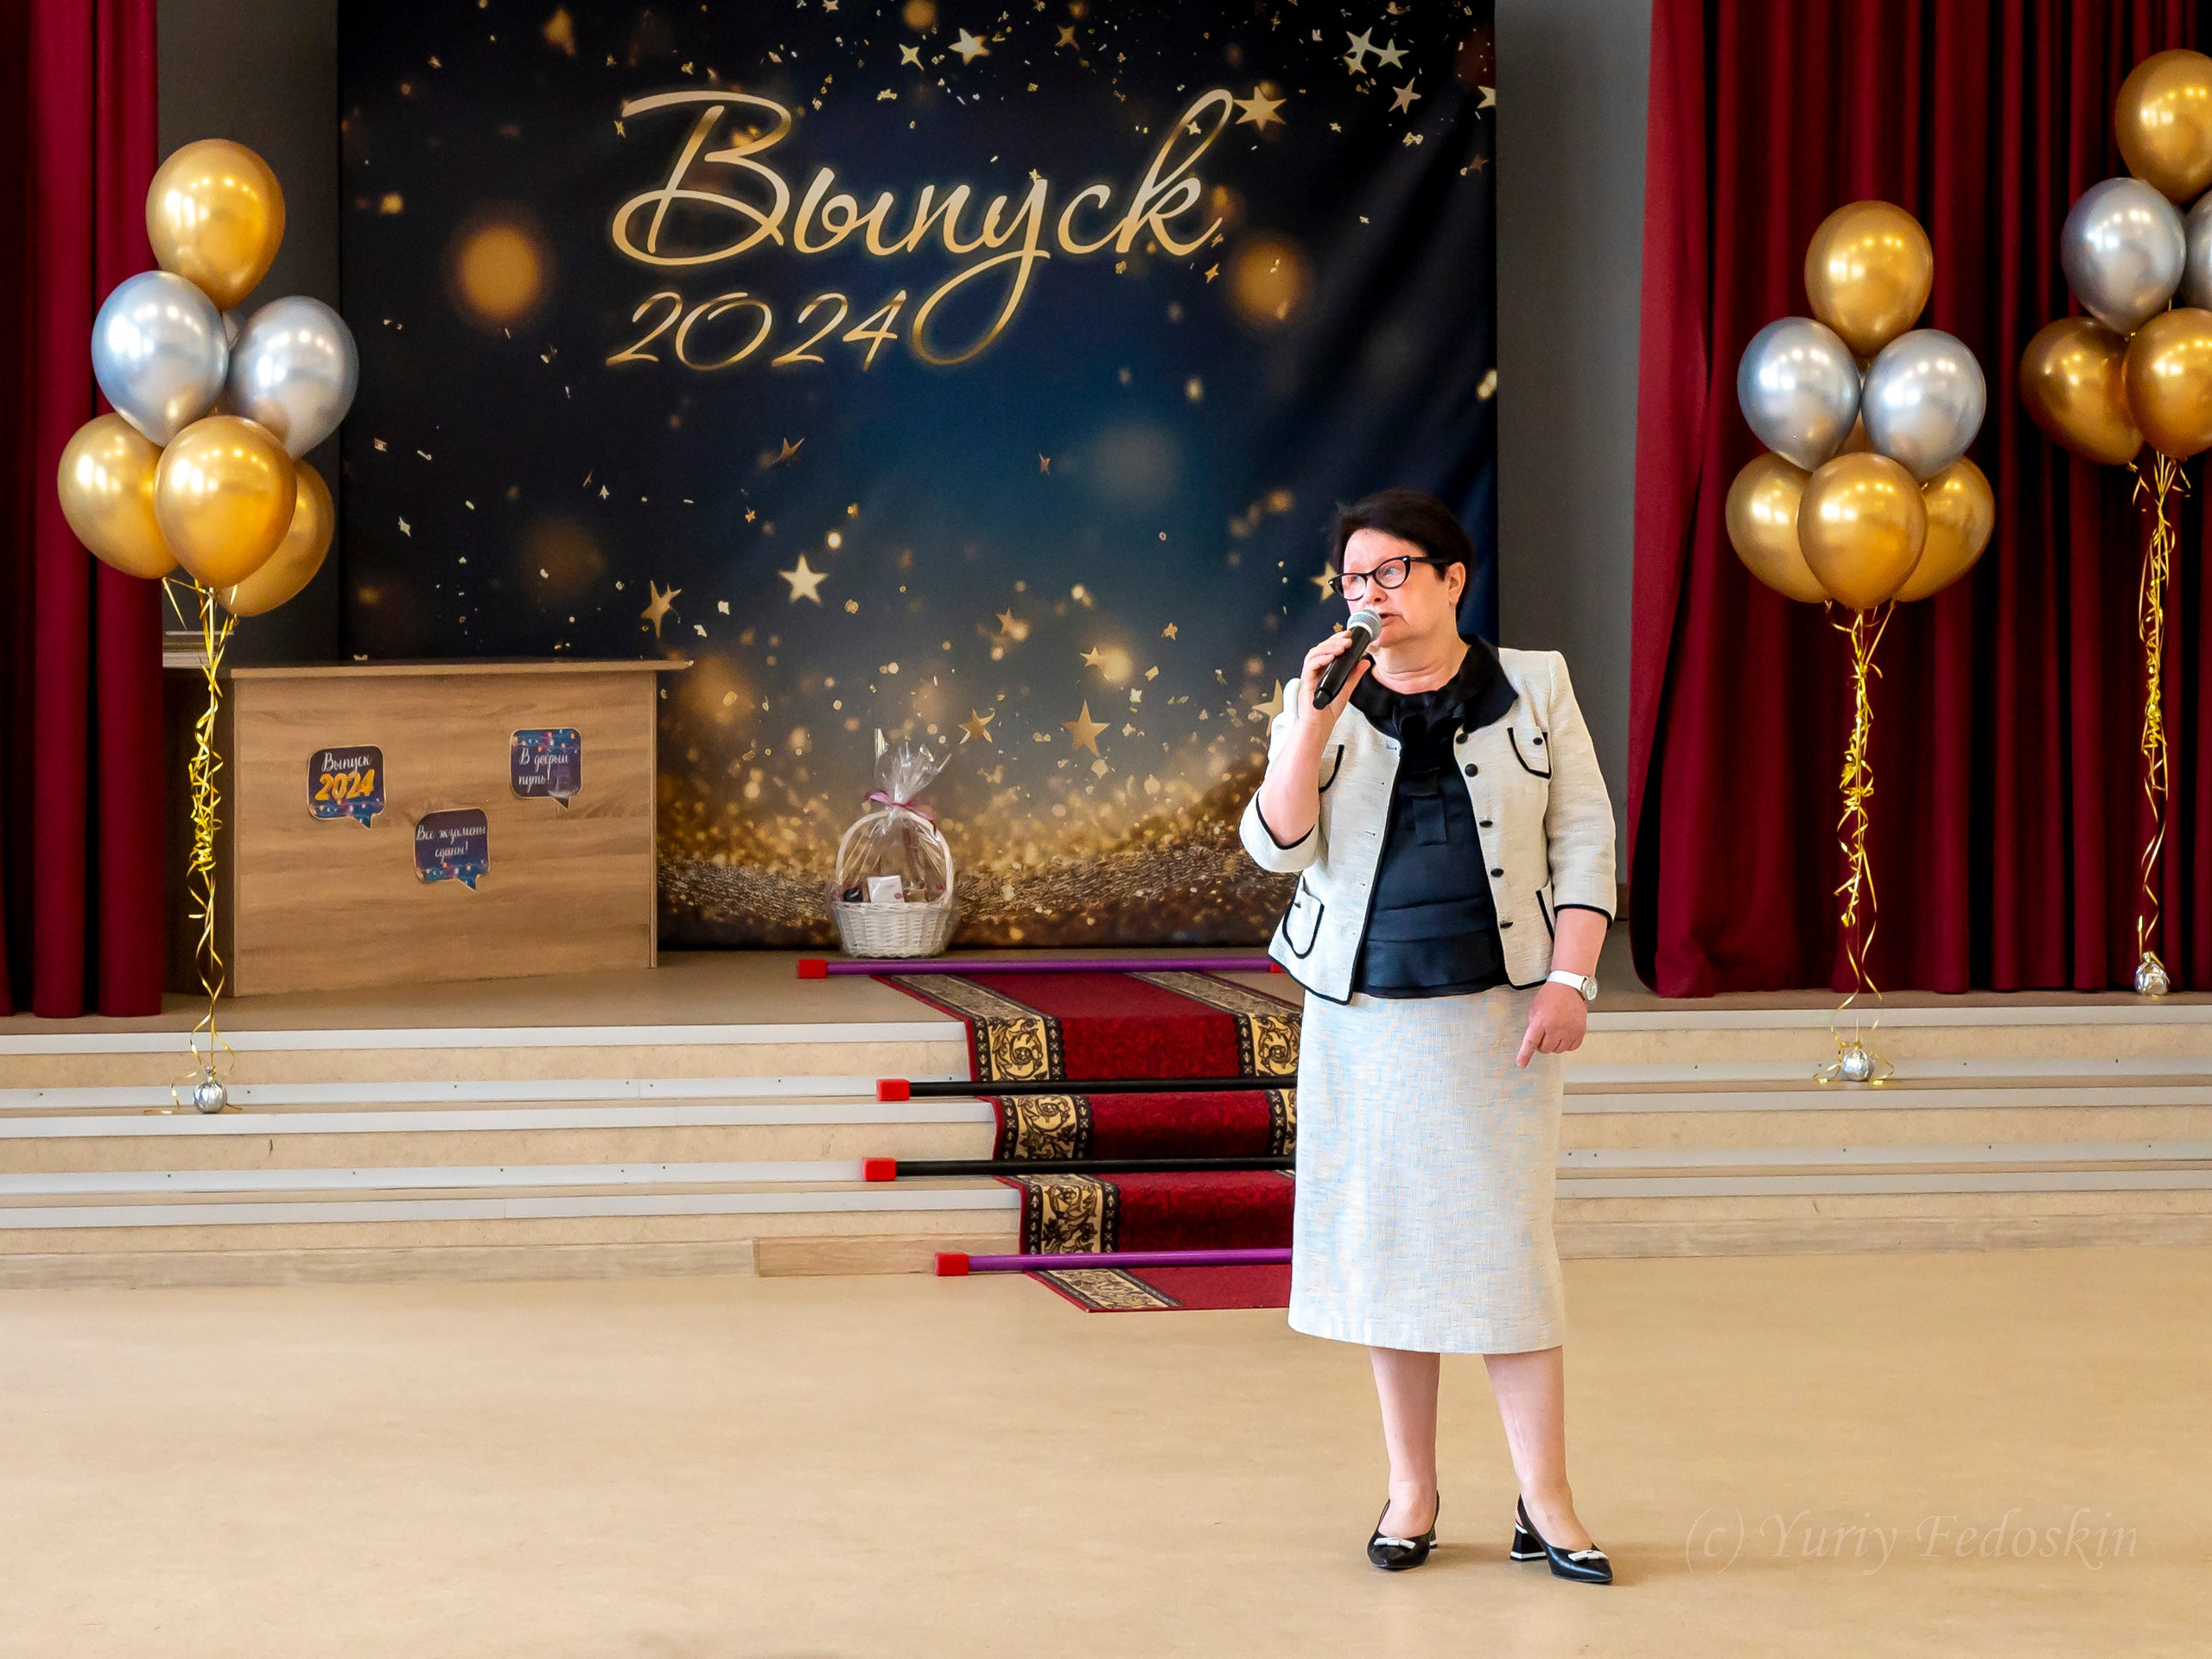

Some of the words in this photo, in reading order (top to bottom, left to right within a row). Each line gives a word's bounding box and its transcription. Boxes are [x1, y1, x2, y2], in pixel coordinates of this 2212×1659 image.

[612, 89, 1233, 365] Выпуск
[606, 289, 907, 372] 2024
[321, 752, 372, 775] Выпуск
[519, 747, 530, 765] В
[314, 768, 375, 801] 2024
[518, 767, 550, 793] путь!
[416, 825, 435, 841] Все
[435, 841, 467, 864] сданы!
